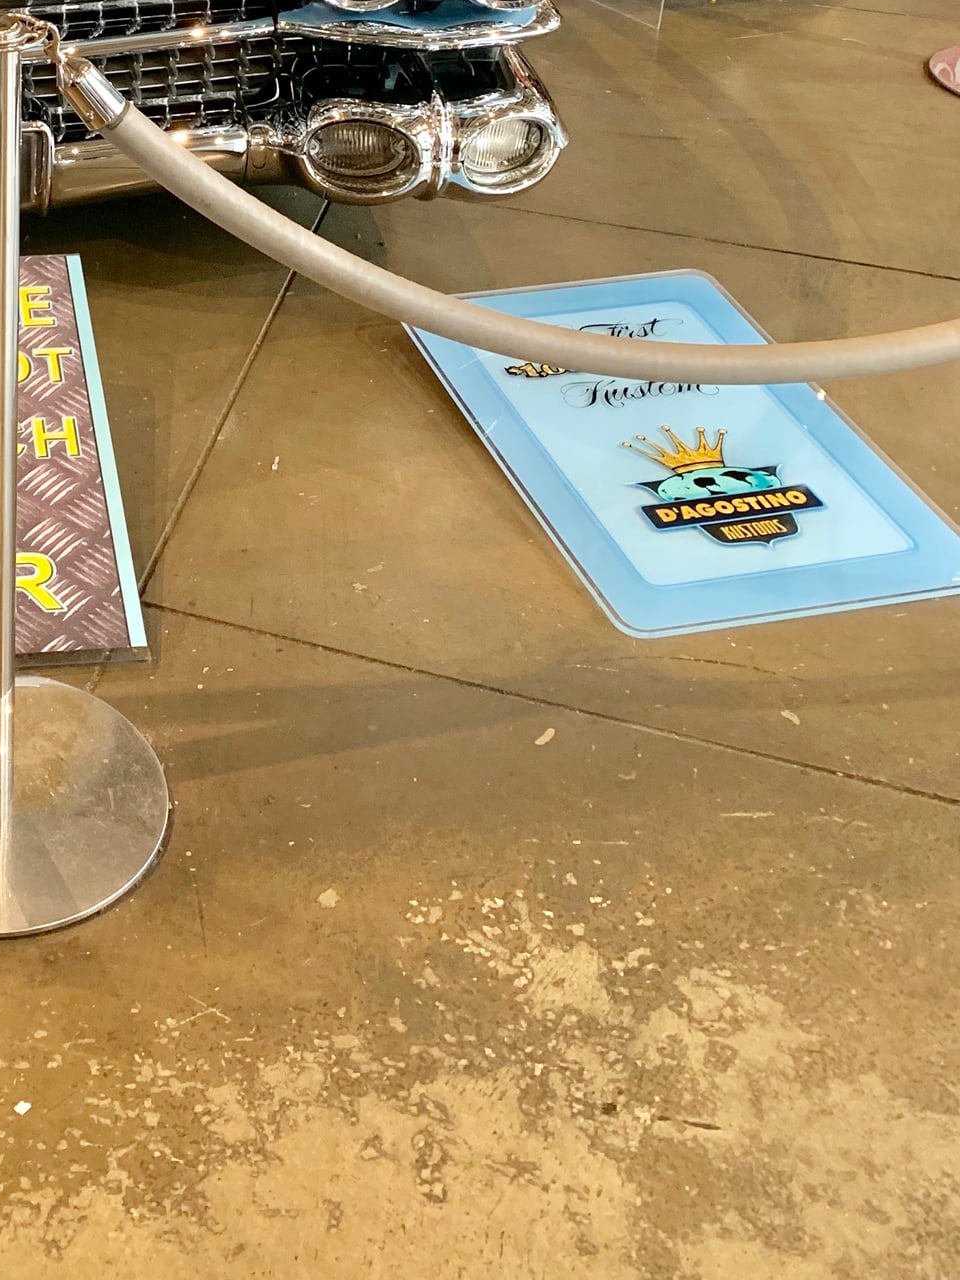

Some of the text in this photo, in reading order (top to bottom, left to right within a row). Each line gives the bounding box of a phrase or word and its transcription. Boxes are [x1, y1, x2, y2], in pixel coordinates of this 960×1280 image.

[560, 380, 720, 409] Kustom
[655, 490, 808, 524] D'AGOSTINO
[719, 519, 788, 541] KUSTOMS
